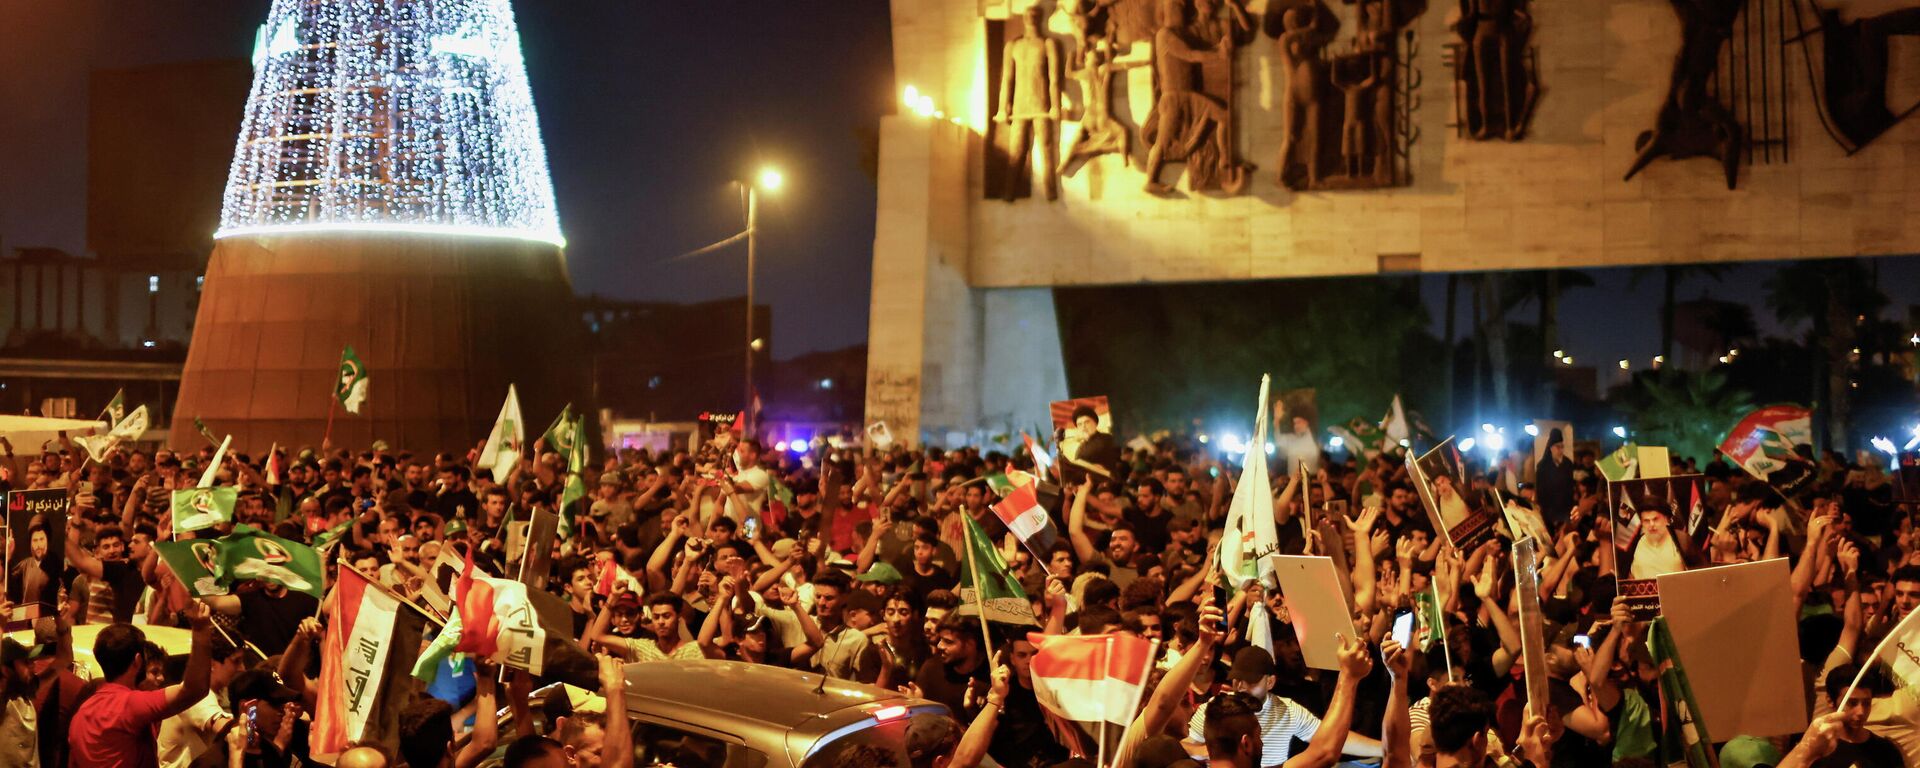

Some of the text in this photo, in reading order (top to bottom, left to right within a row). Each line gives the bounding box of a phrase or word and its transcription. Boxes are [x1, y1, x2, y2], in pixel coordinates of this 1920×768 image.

[26, 500, 34, 511] الا
[35, 500, 52, 513] نركع
[53, 498, 63, 511] لن
[356, 637, 380, 665] الله
